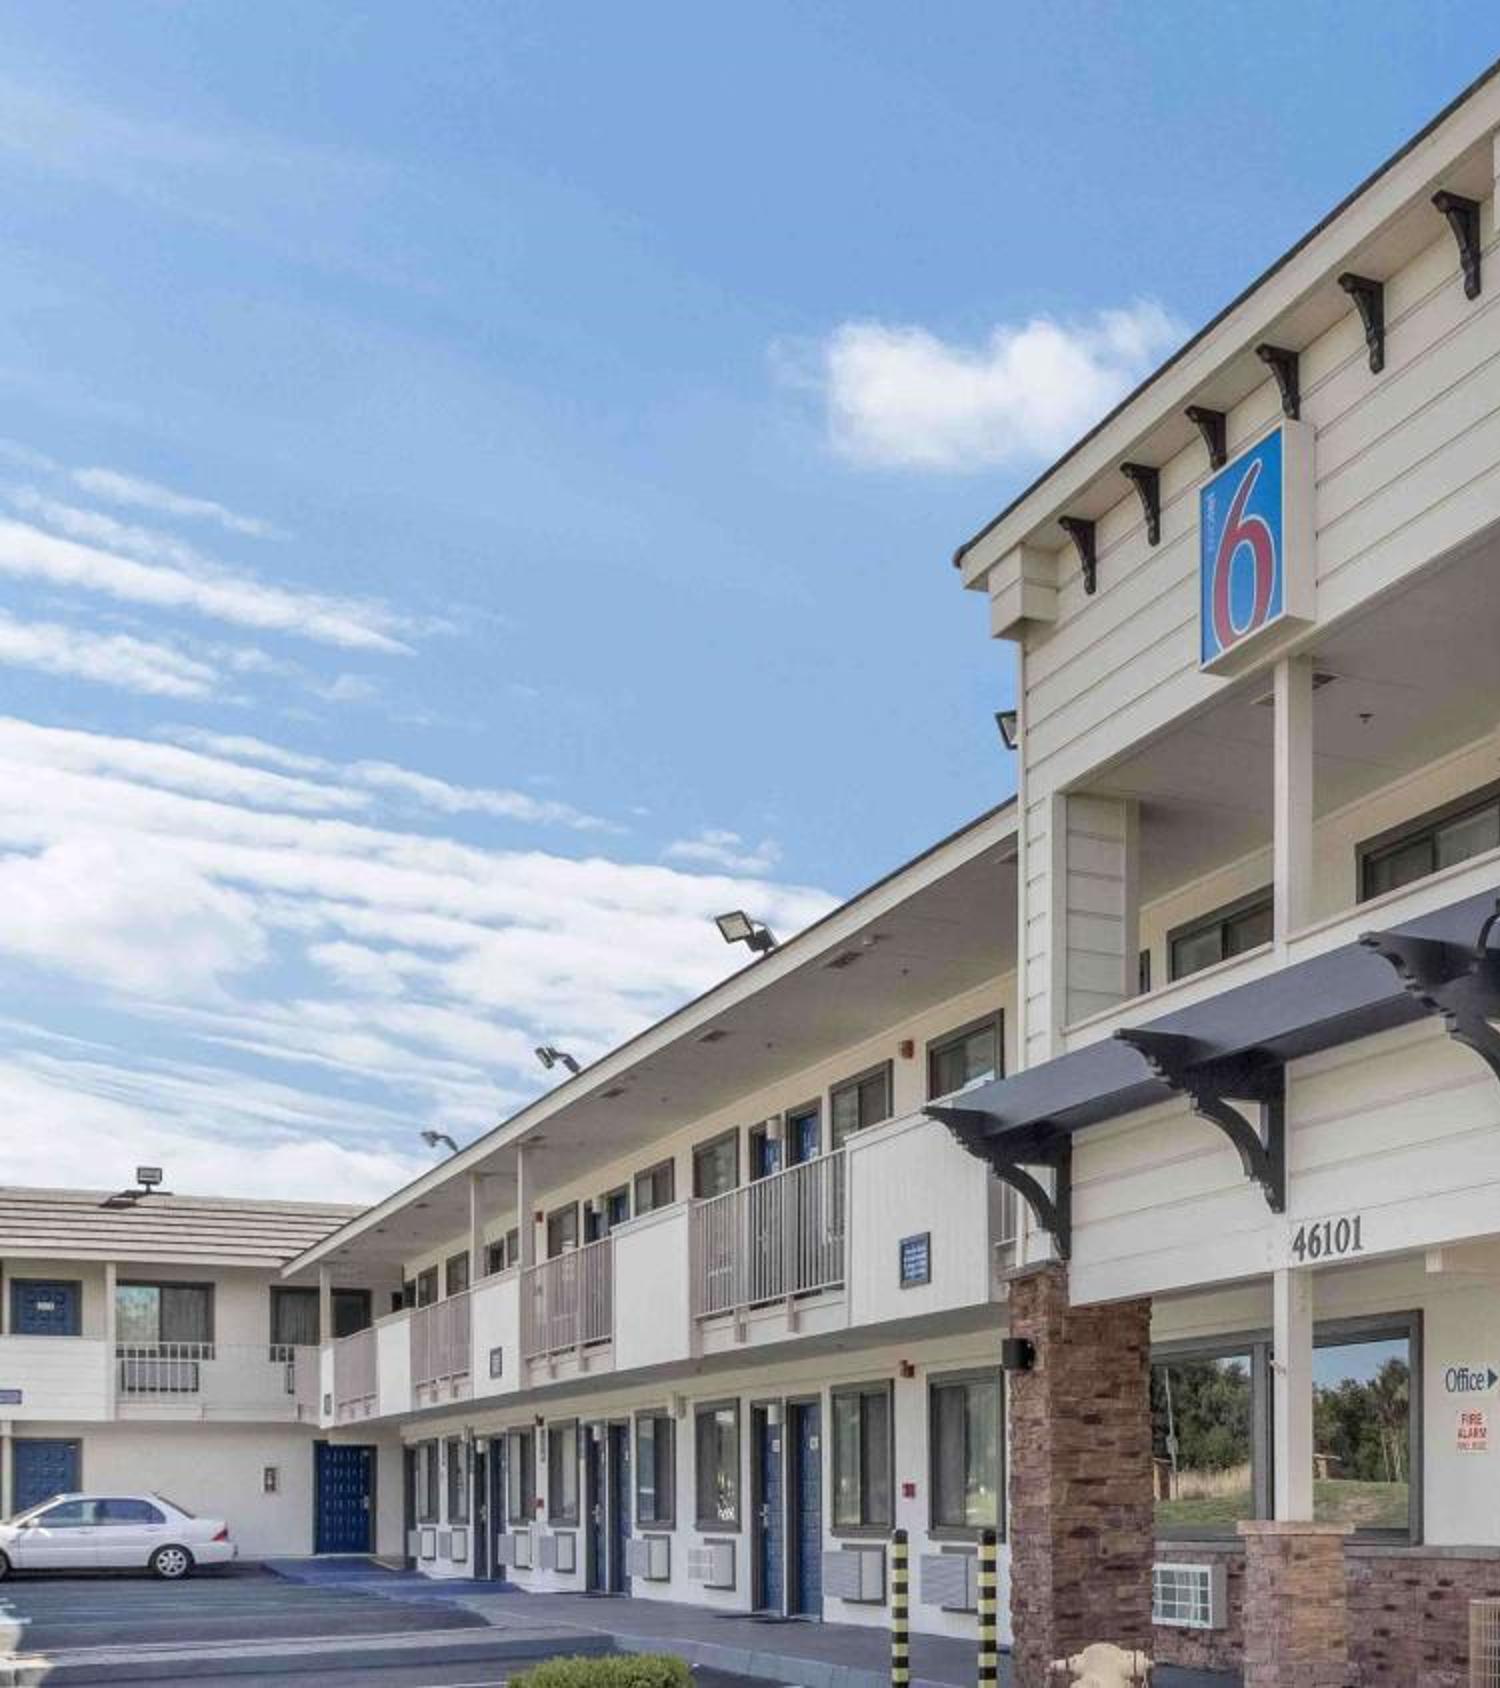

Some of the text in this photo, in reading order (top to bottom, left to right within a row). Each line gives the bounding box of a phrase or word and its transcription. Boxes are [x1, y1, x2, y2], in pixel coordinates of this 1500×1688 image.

[1211, 458, 1275, 651] 6
[1292, 1215, 1363, 1262] 46101
[1445, 1367, 1485, 1393] Office
[1461, 1413, 1483, 1425] FIRE
